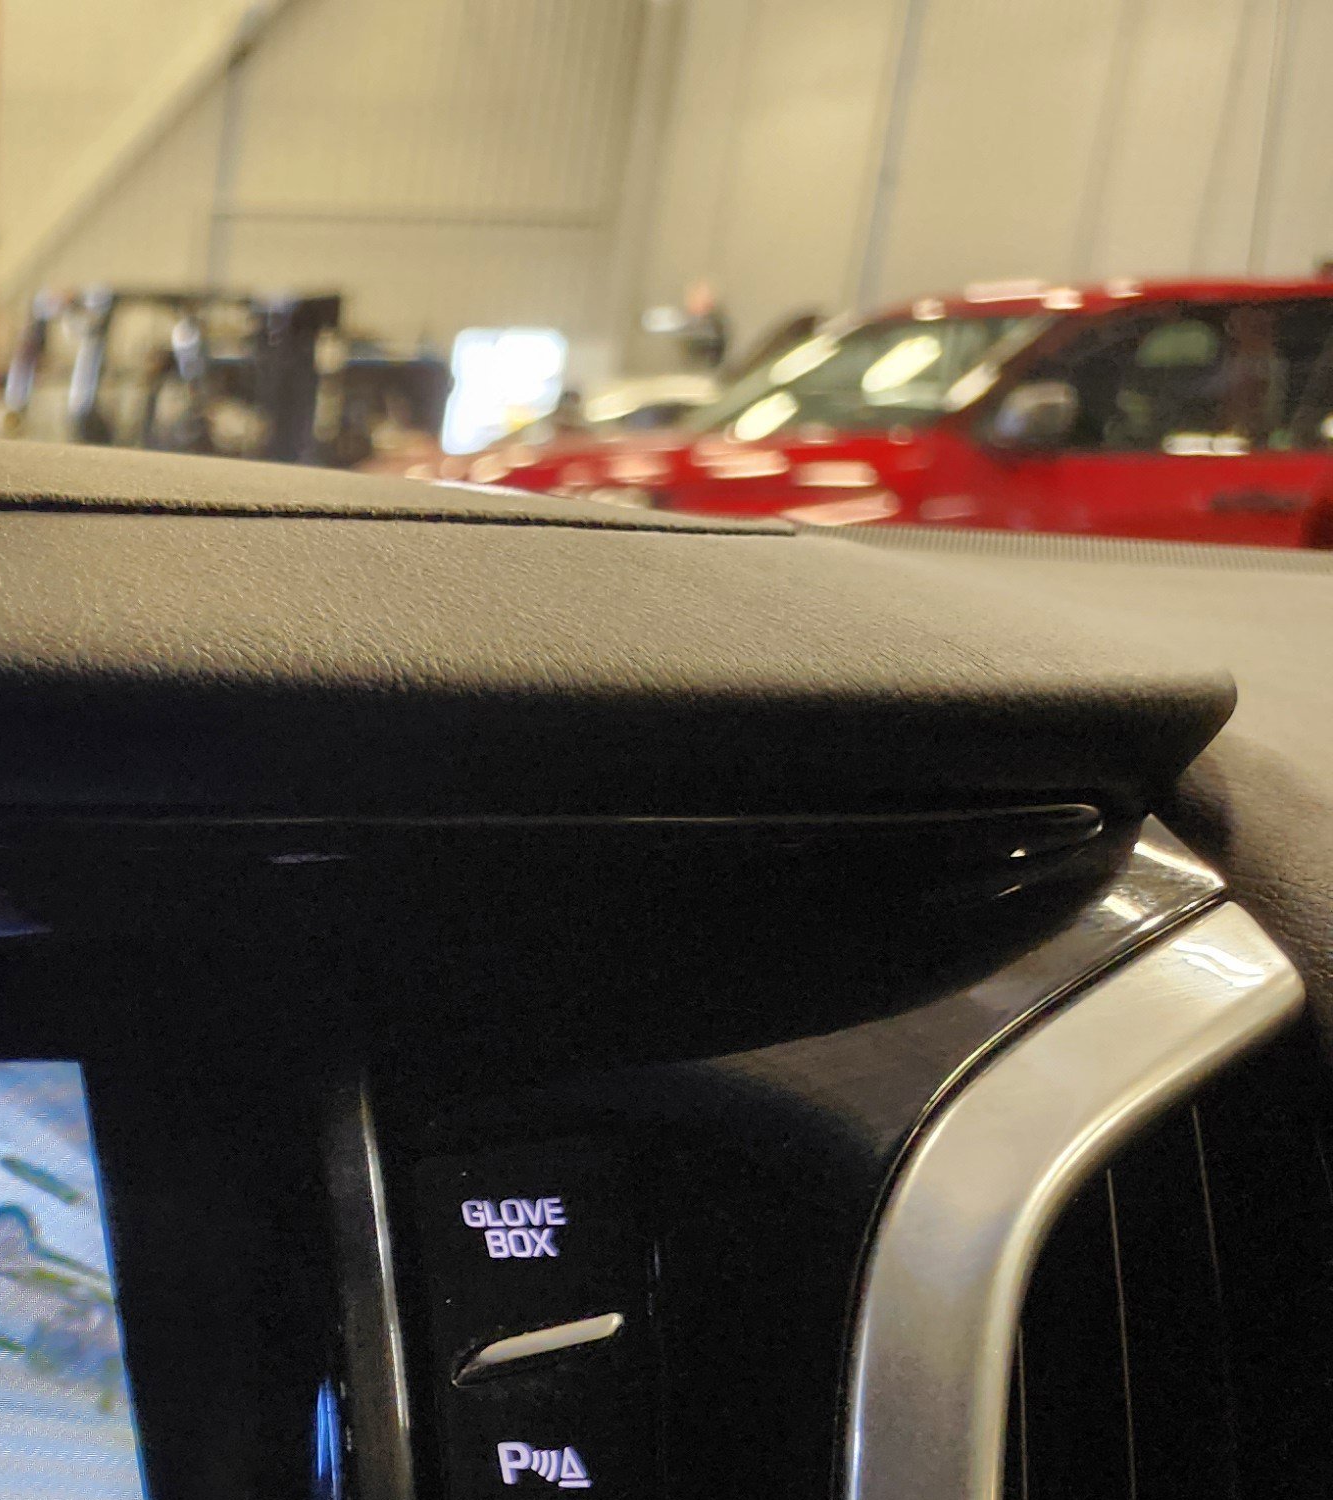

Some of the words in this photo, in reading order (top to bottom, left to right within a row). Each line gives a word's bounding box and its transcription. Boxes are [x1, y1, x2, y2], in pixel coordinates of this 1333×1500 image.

[461, 1197, 567, 1228] GLOVE
[484, 1228, 559, 1259] BOX
[497, 1441, 531, 1485] P
